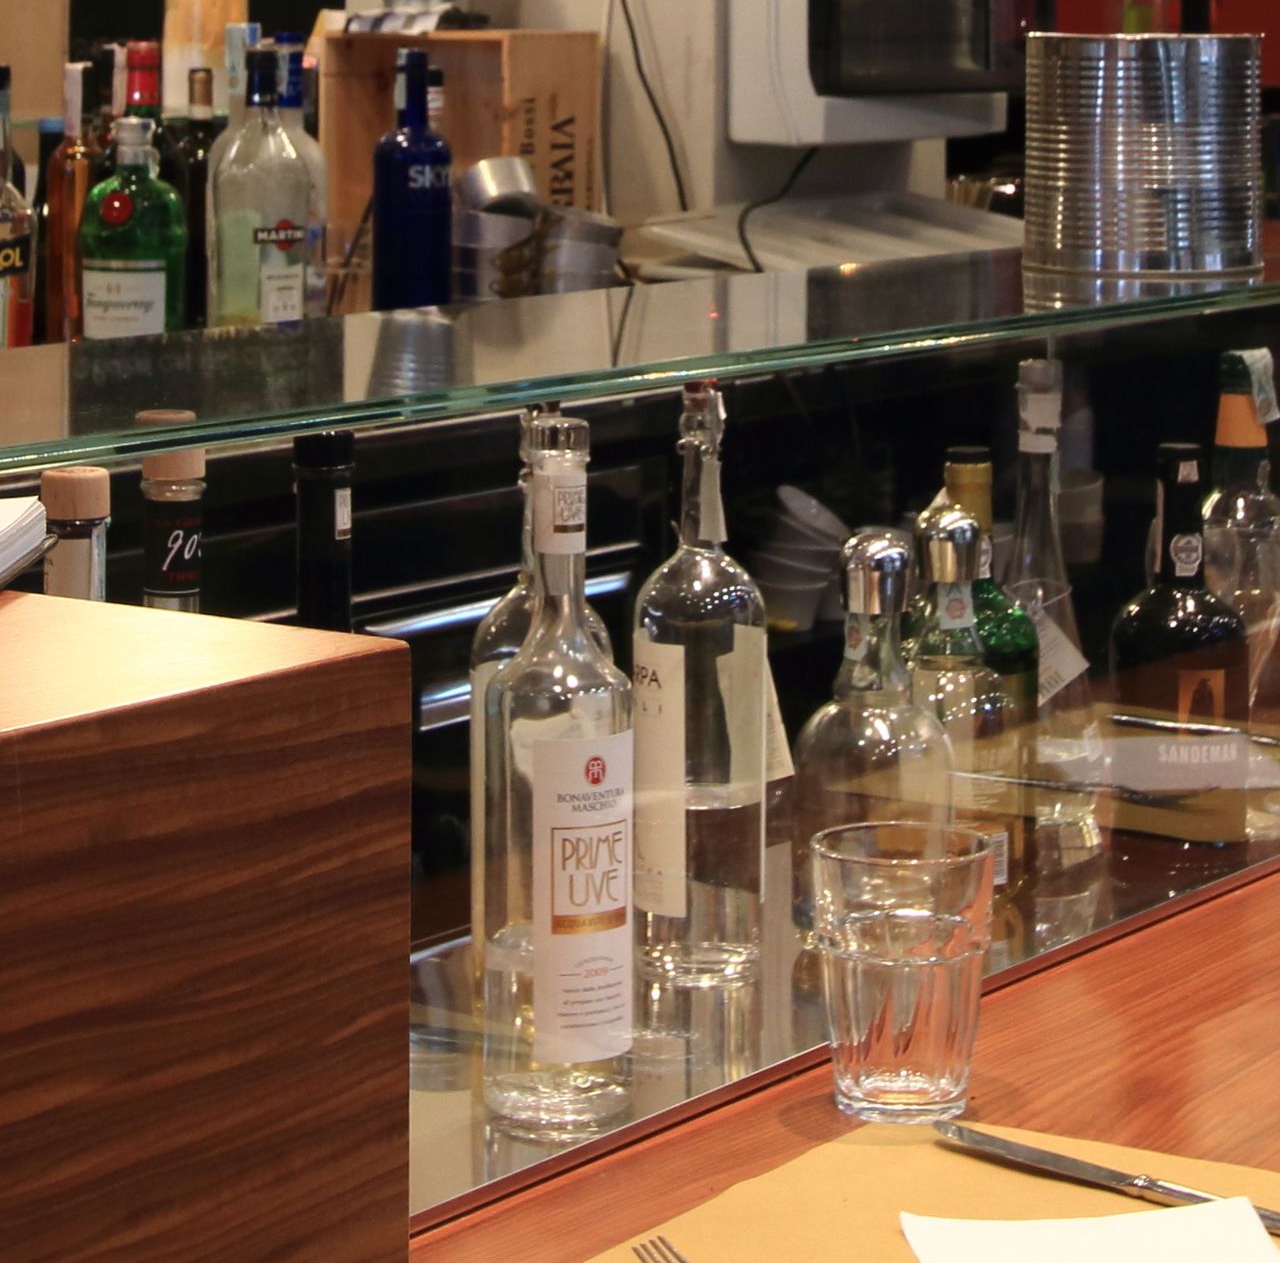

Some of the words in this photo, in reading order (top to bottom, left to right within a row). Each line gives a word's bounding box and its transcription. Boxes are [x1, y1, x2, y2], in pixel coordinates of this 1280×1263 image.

[556, 787, 625, 804] BONAVENTURA
[571, 799, 618, 813] MASCHIO
[561, 830, 623, 871] PRIME
[569, 868, 619, 907] UVE
